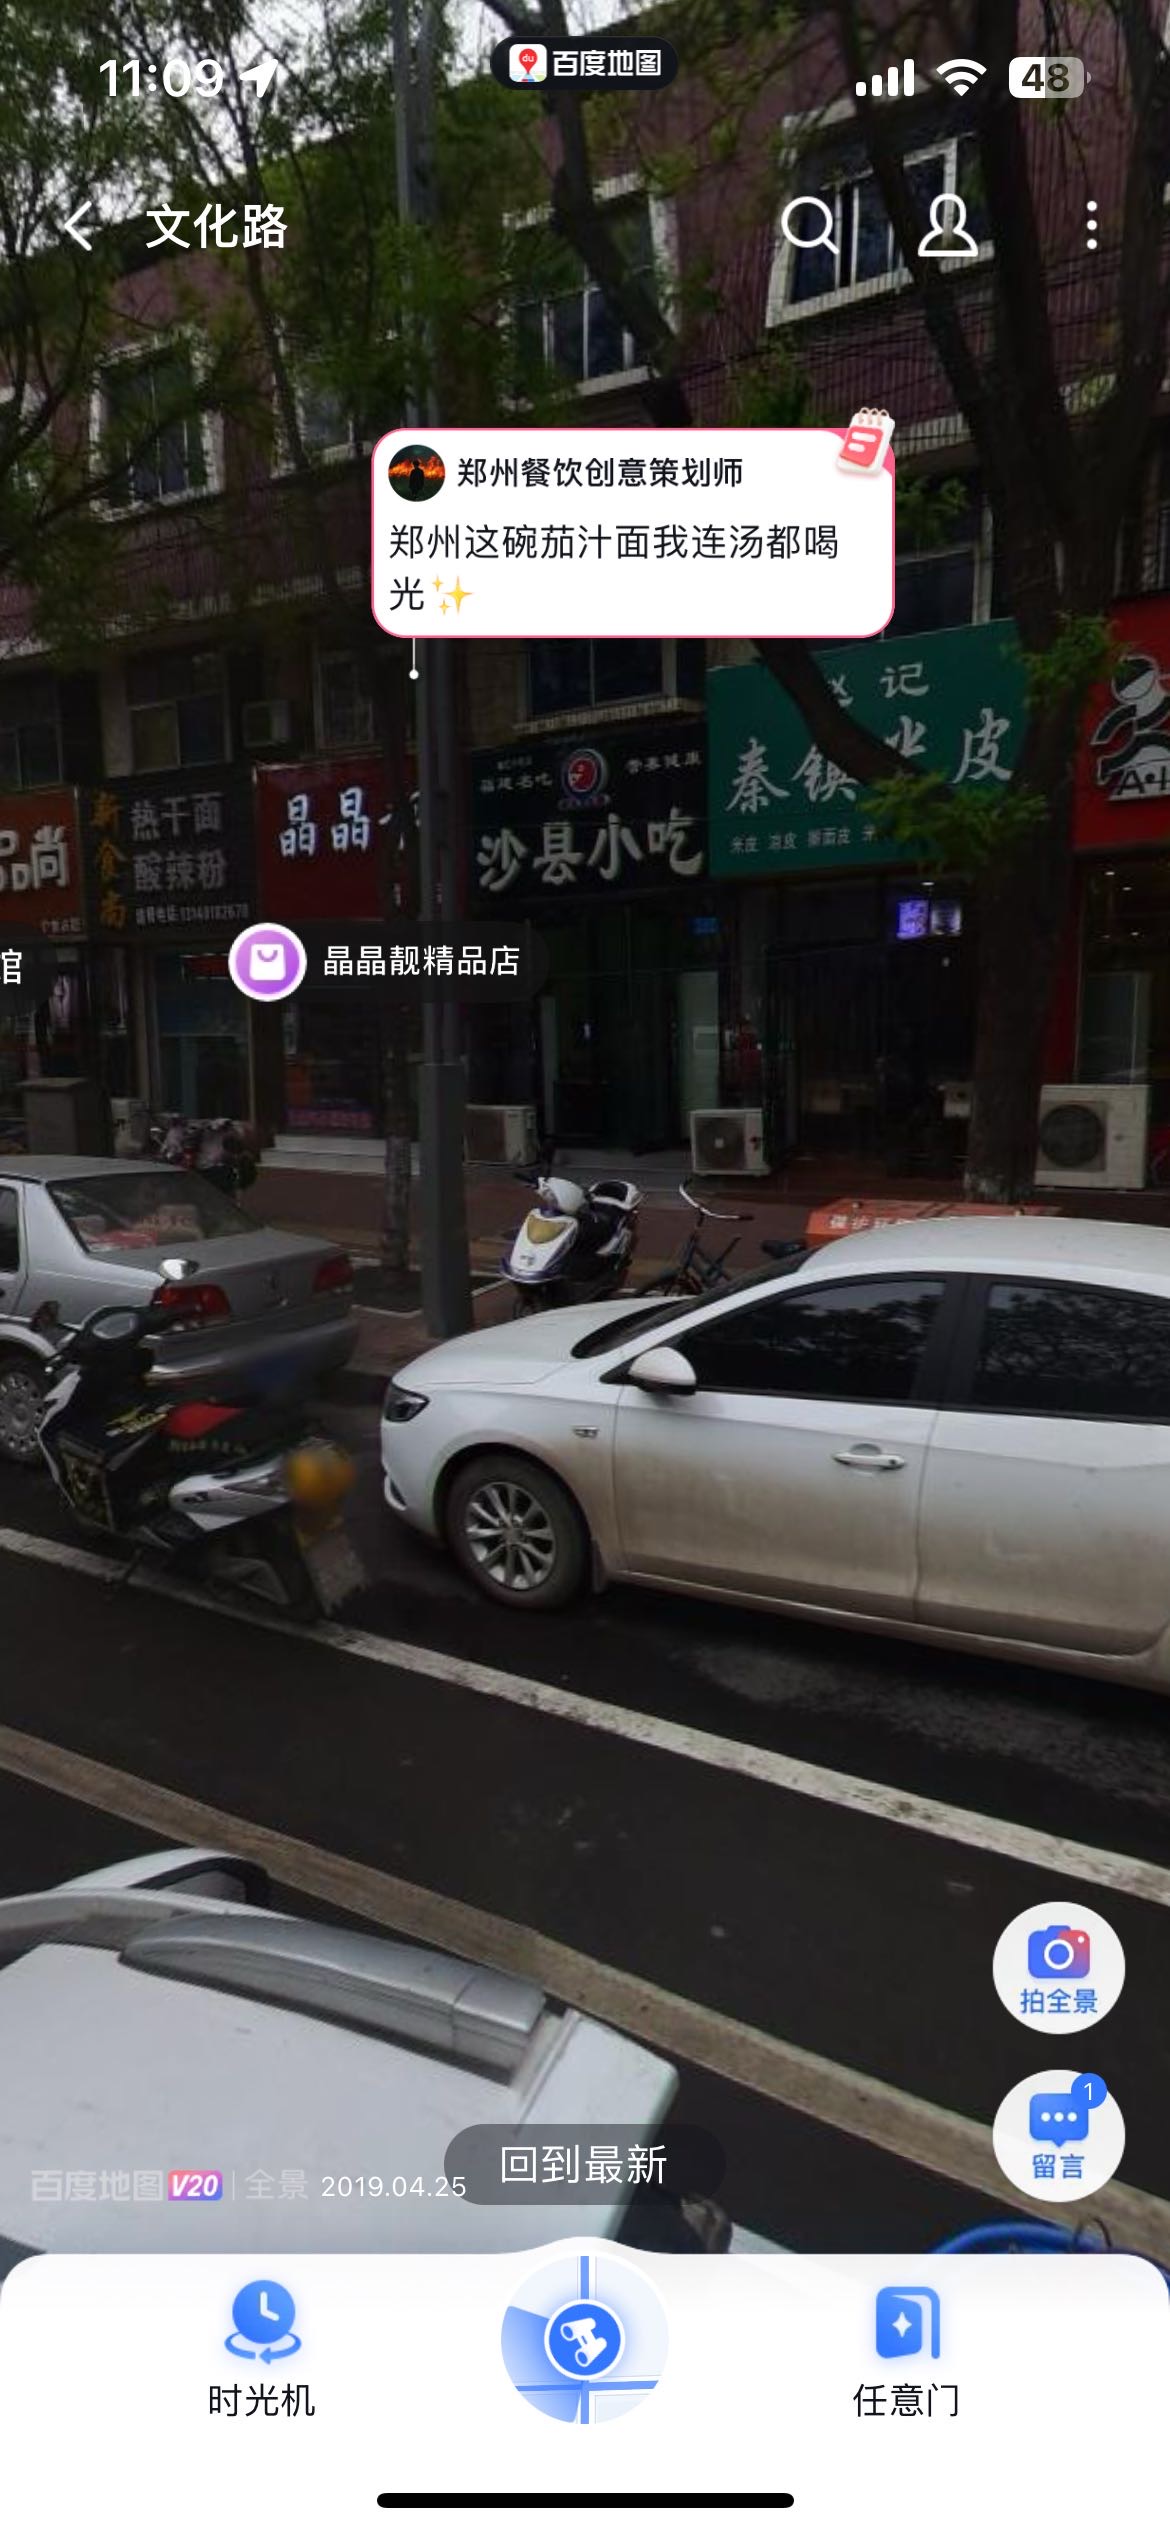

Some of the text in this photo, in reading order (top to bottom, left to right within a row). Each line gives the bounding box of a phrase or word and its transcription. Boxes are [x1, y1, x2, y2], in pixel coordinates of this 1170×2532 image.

[130, 791, 222, 842] 热干面
[132, 849, 228, 893] 酸辣粉
[476, 805, 704, 893] 沙县小吃
